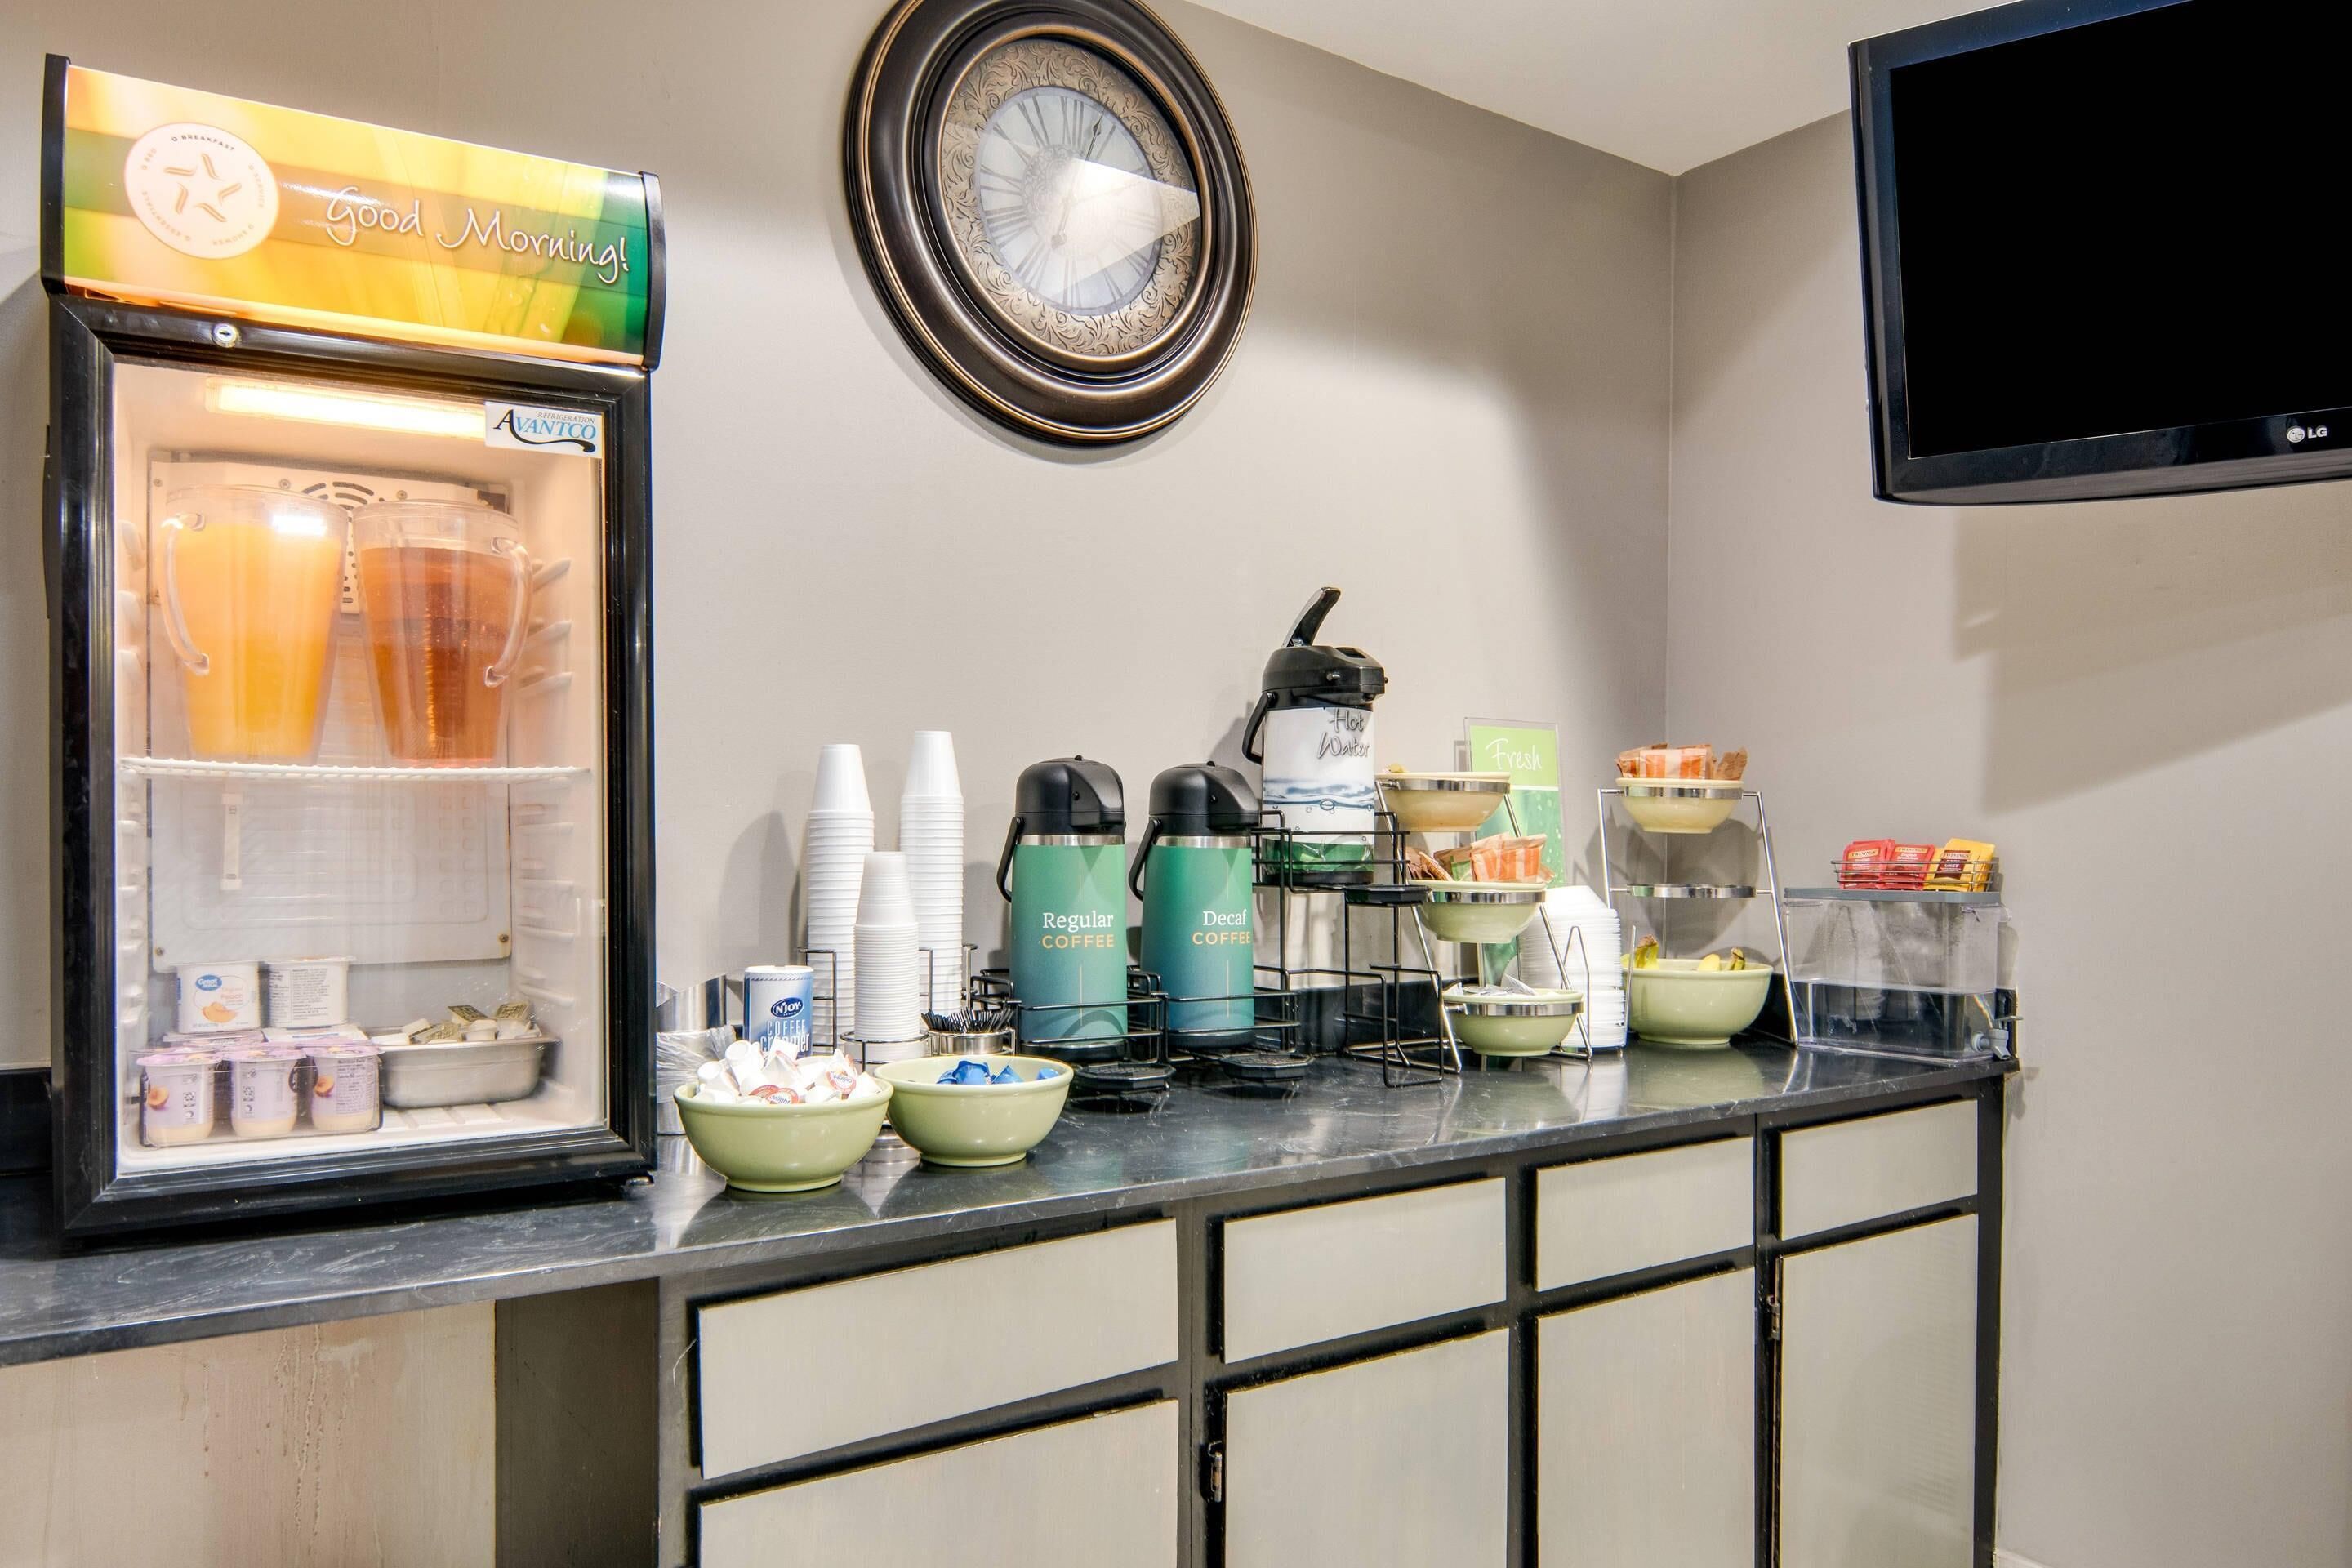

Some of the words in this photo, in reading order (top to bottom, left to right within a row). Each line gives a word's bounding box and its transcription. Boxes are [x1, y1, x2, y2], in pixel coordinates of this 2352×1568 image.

[180, 135, 235, 151] BREAKFAST
[326, 186, 425, 247] Good
[435, 208, 630, 285] Morning!
[537, 412, 595, 424] REFRIGERATION
[492, 409, 597, 453] AVANTCO
[2307, 425, 2328, 439] LG
[1328, 708, 1365, 733] Hot
[1316, 731, 1370, 760] Water
[1485, 737, 1543, 771] Fresh
[1042, 910, 1115, 933] Regular
[1202, 908, 1248, 927] Decaf
[1041, 934, 1115, 949] COFFEE
[1191, 931, 1252, 946] COFFEE
[767, 1019, 806, 1036] COFFEE
[760, 1032, 810, 1053] crmer
